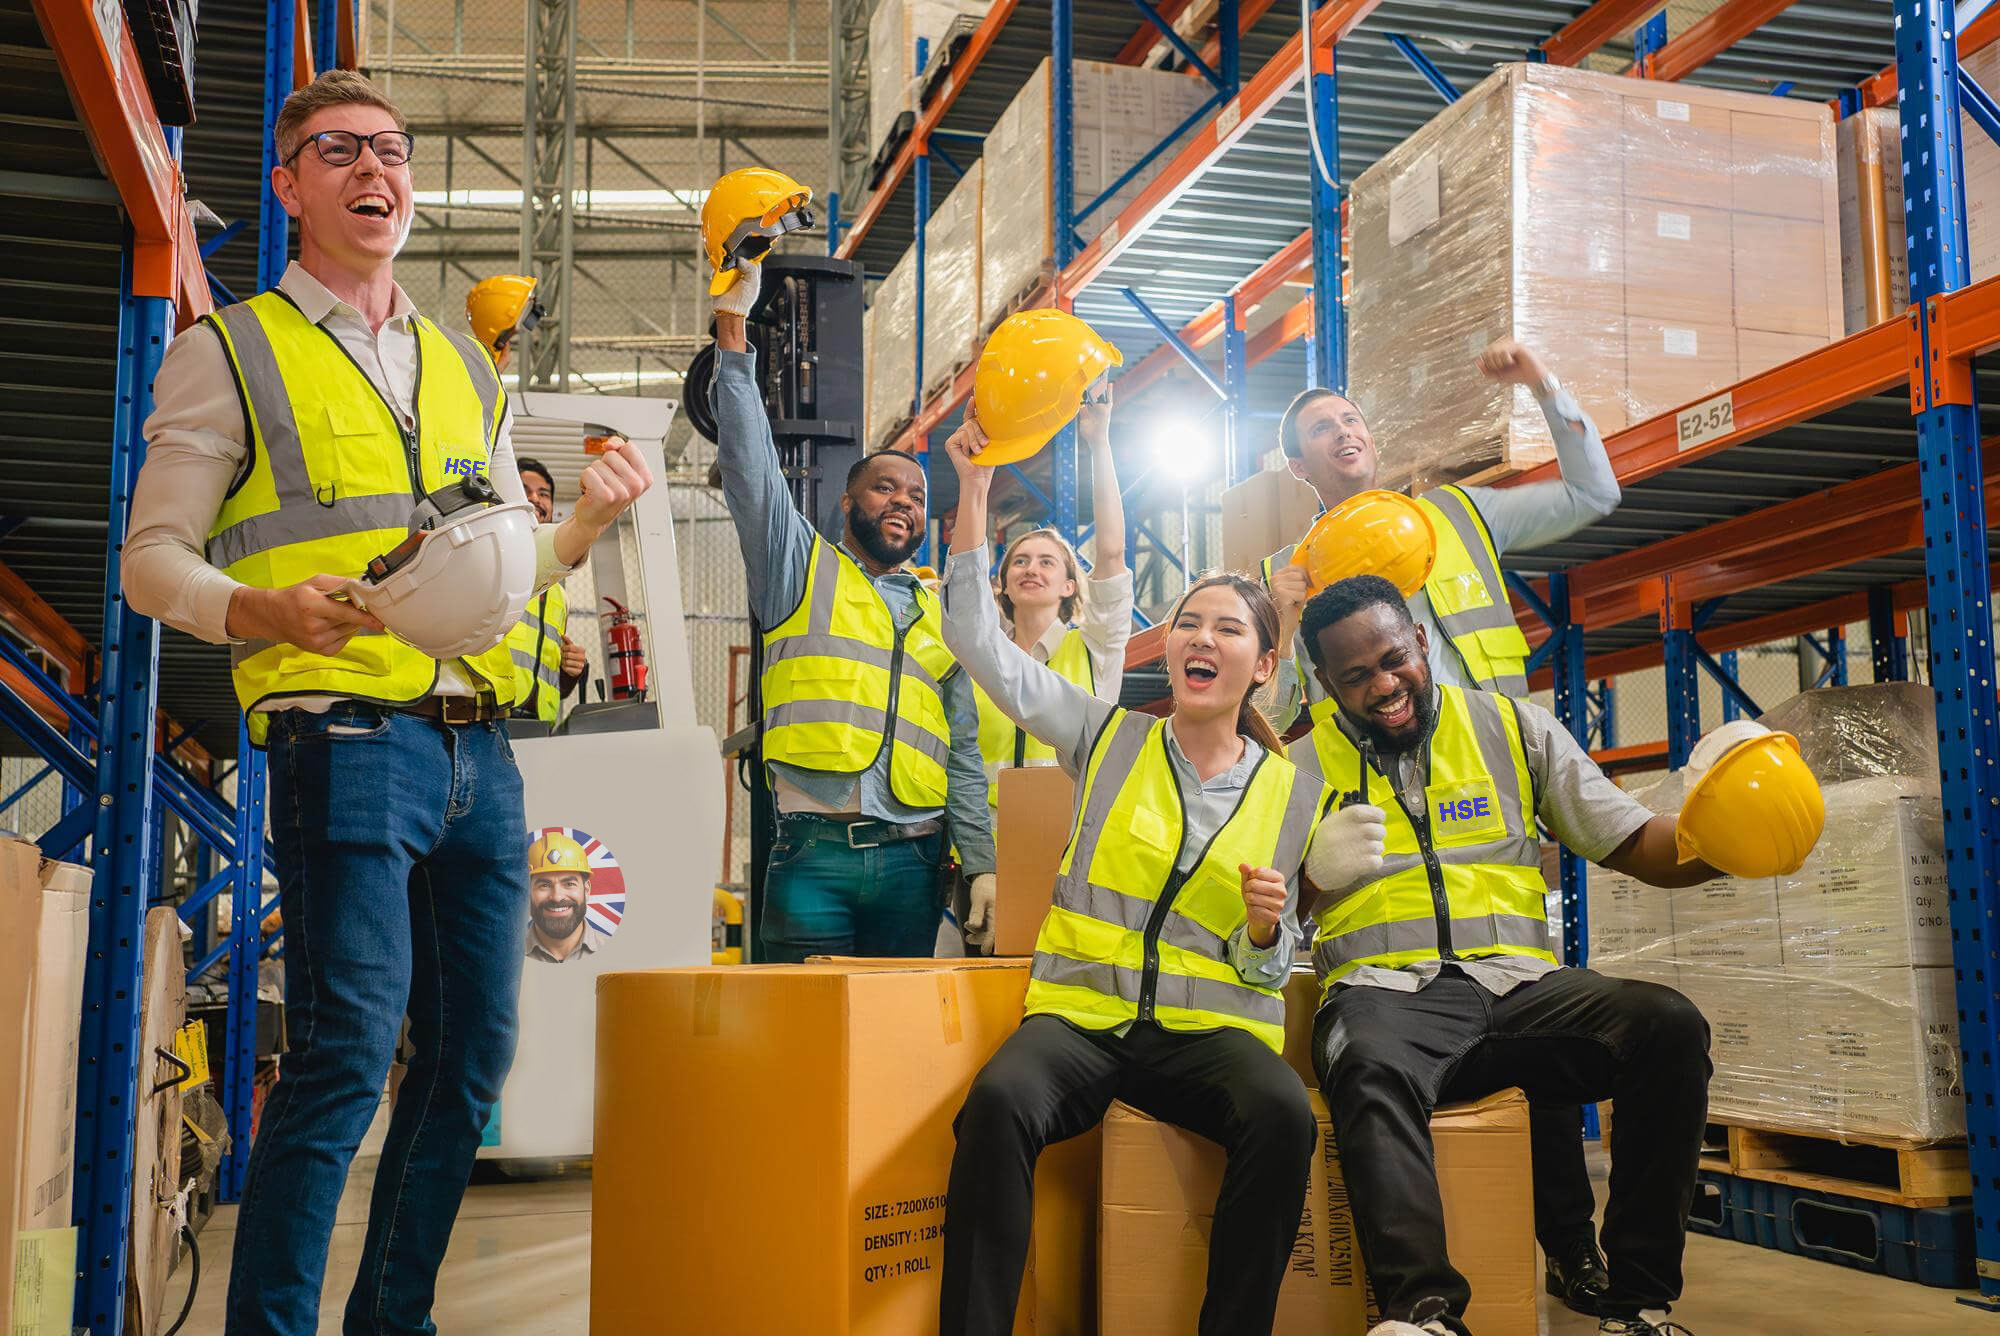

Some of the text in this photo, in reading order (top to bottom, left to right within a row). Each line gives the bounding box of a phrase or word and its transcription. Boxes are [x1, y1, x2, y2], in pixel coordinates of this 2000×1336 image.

[1680, 402, 1732, 441] E2-52
[1439, 797, 1490, 822] HSE
[864, 1204, 888, 1221] SIZE
[896, 1194, 949, 1216] 7200X610
[864, 1230, 912, 1252] DENSITY
[920, 1225, 938, 1241] 128
[864, 1264, 888, 1283] QTY
[904, 1256, 931, 1274] ROLL
